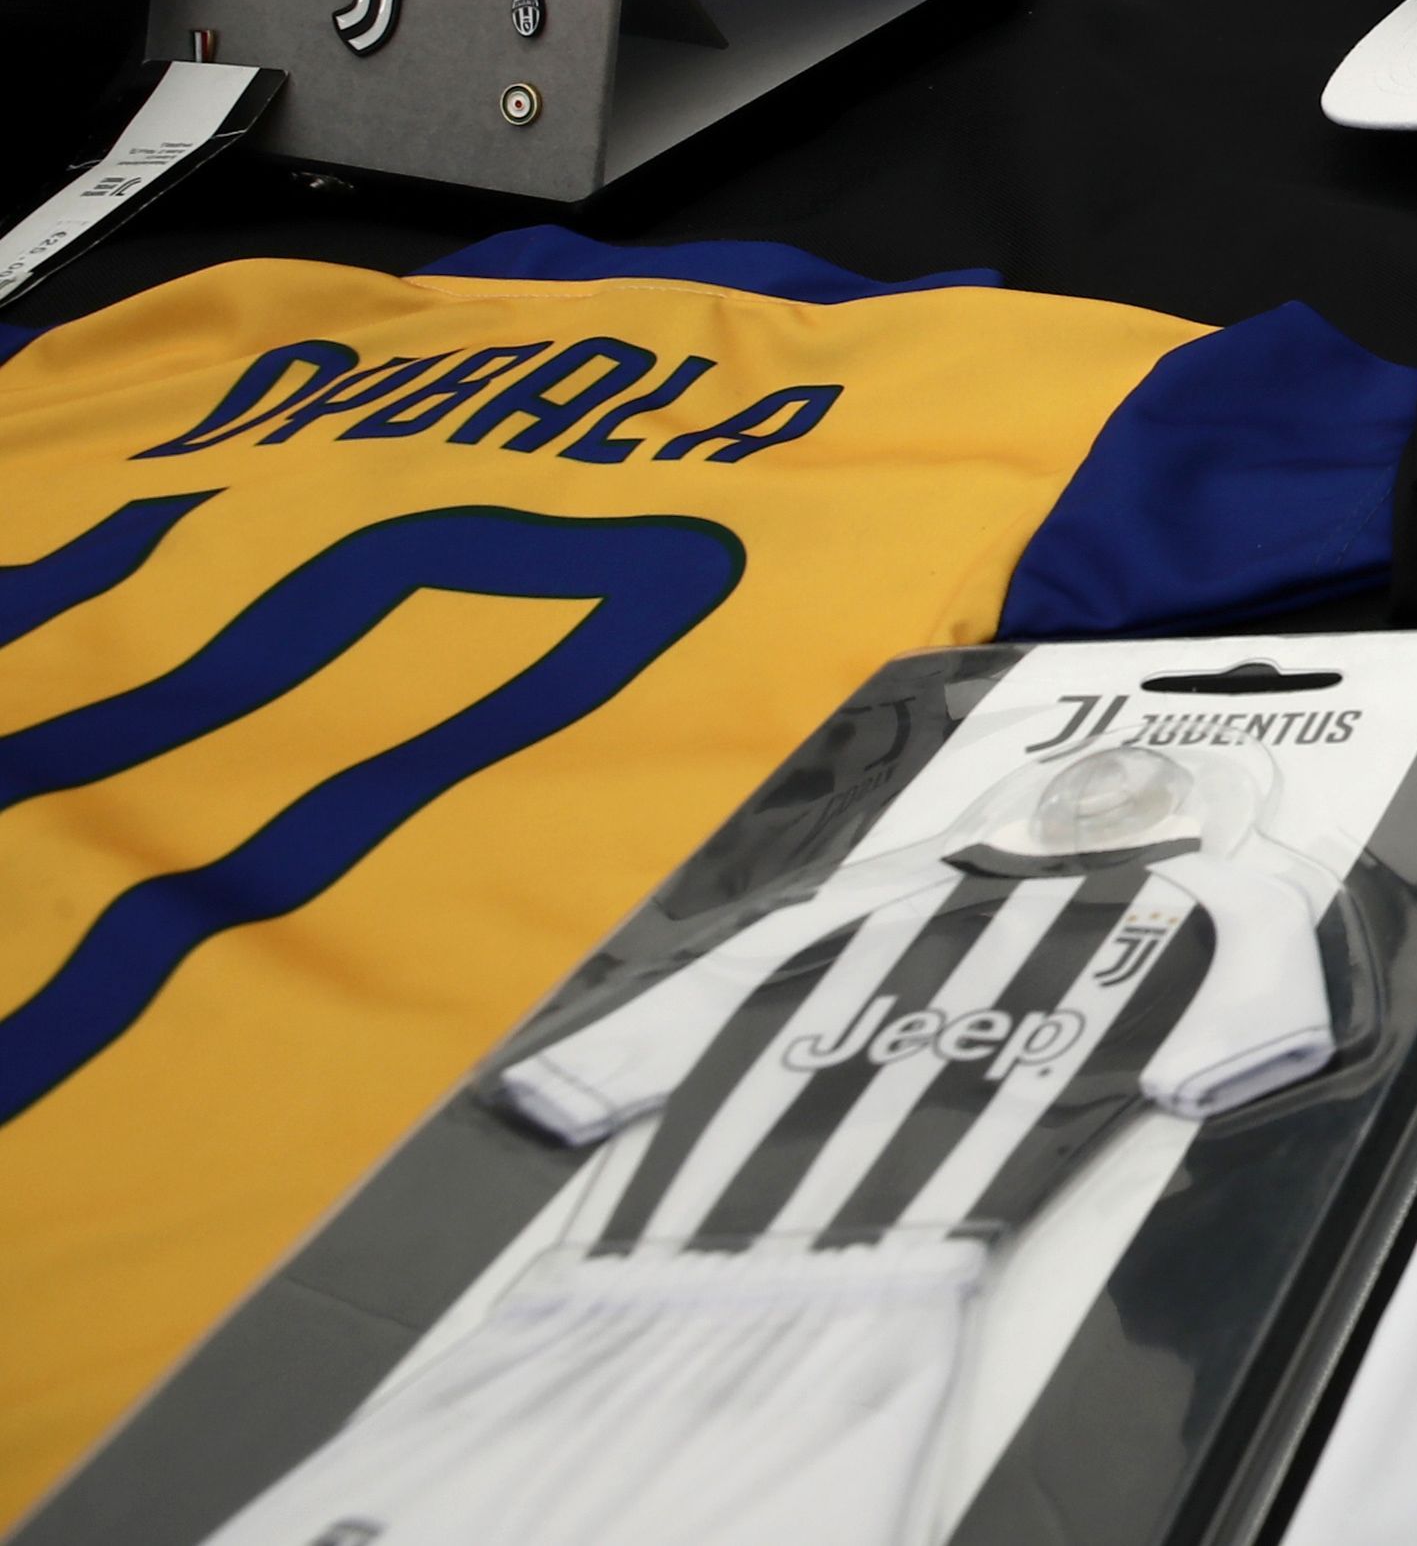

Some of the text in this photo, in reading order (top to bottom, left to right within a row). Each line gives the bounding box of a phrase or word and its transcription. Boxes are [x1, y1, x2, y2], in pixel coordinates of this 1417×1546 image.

[127, 336, 845, 465] DYBALA
[1122, 710, 1362, 748] JUVENTUS
[781, 993, 1087, 1079] Jeep
